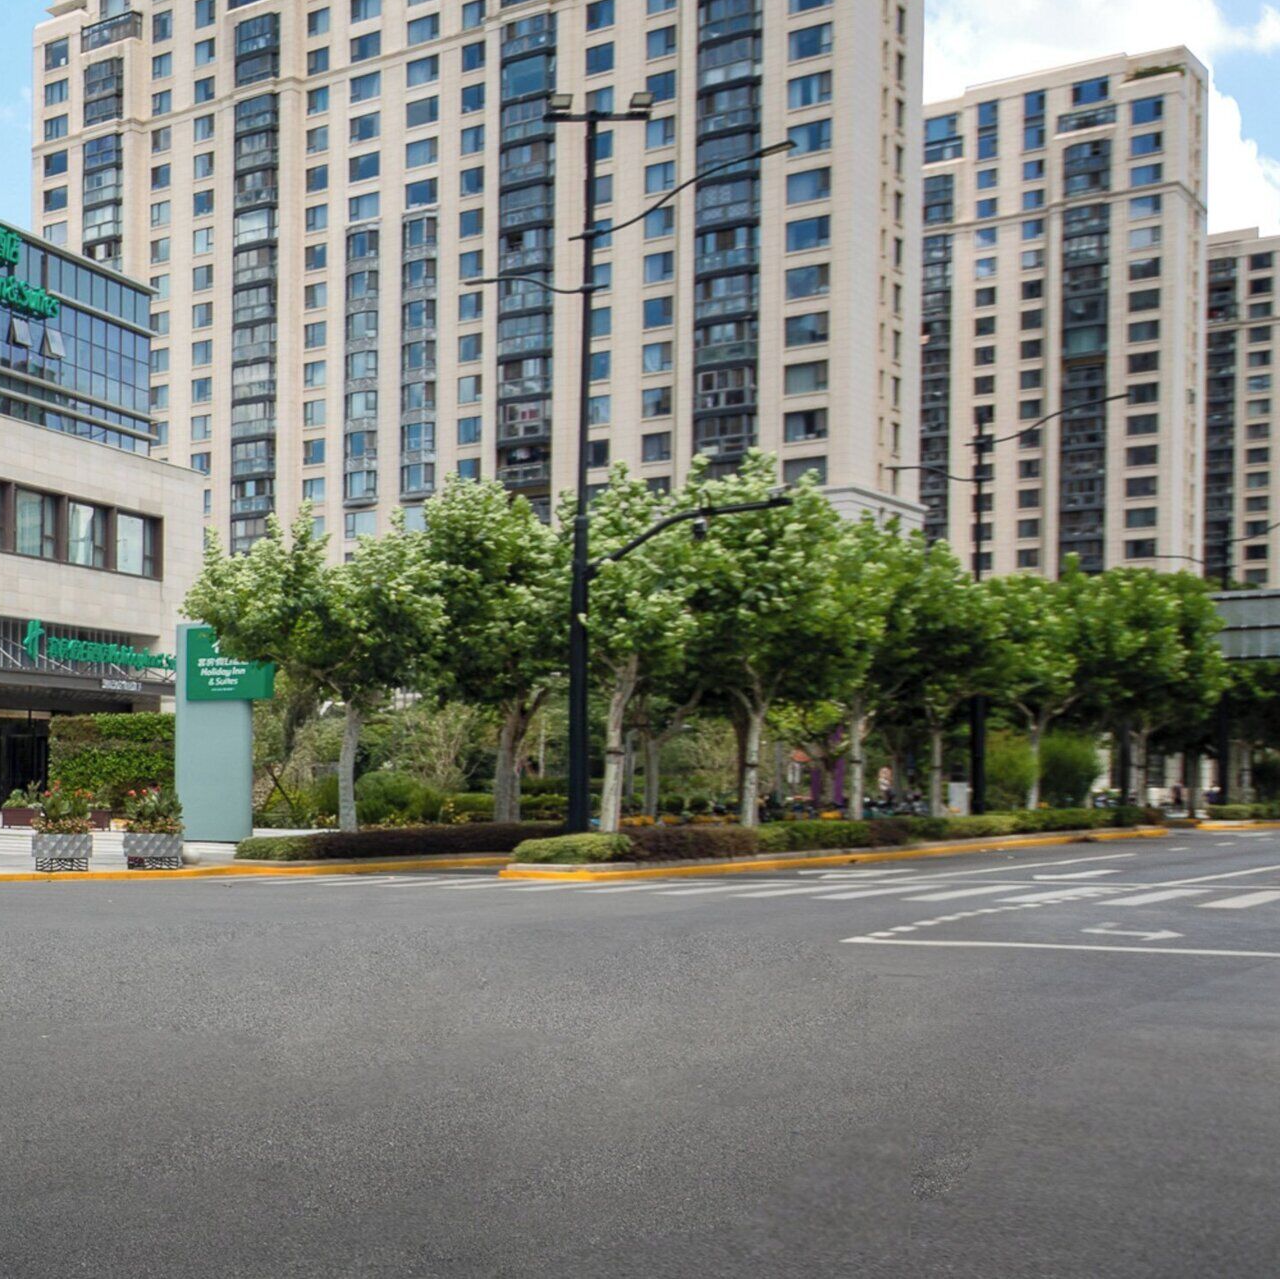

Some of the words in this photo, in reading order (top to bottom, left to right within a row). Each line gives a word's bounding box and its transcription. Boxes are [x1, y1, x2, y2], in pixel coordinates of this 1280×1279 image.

[5, 275, 19, 303] &
[17, 280, 60, 318] Suites
[200, 667, 231, 677] Holiday
[231, 666, 246, 675] Inn
[215, 677, 239, 686] Suites
